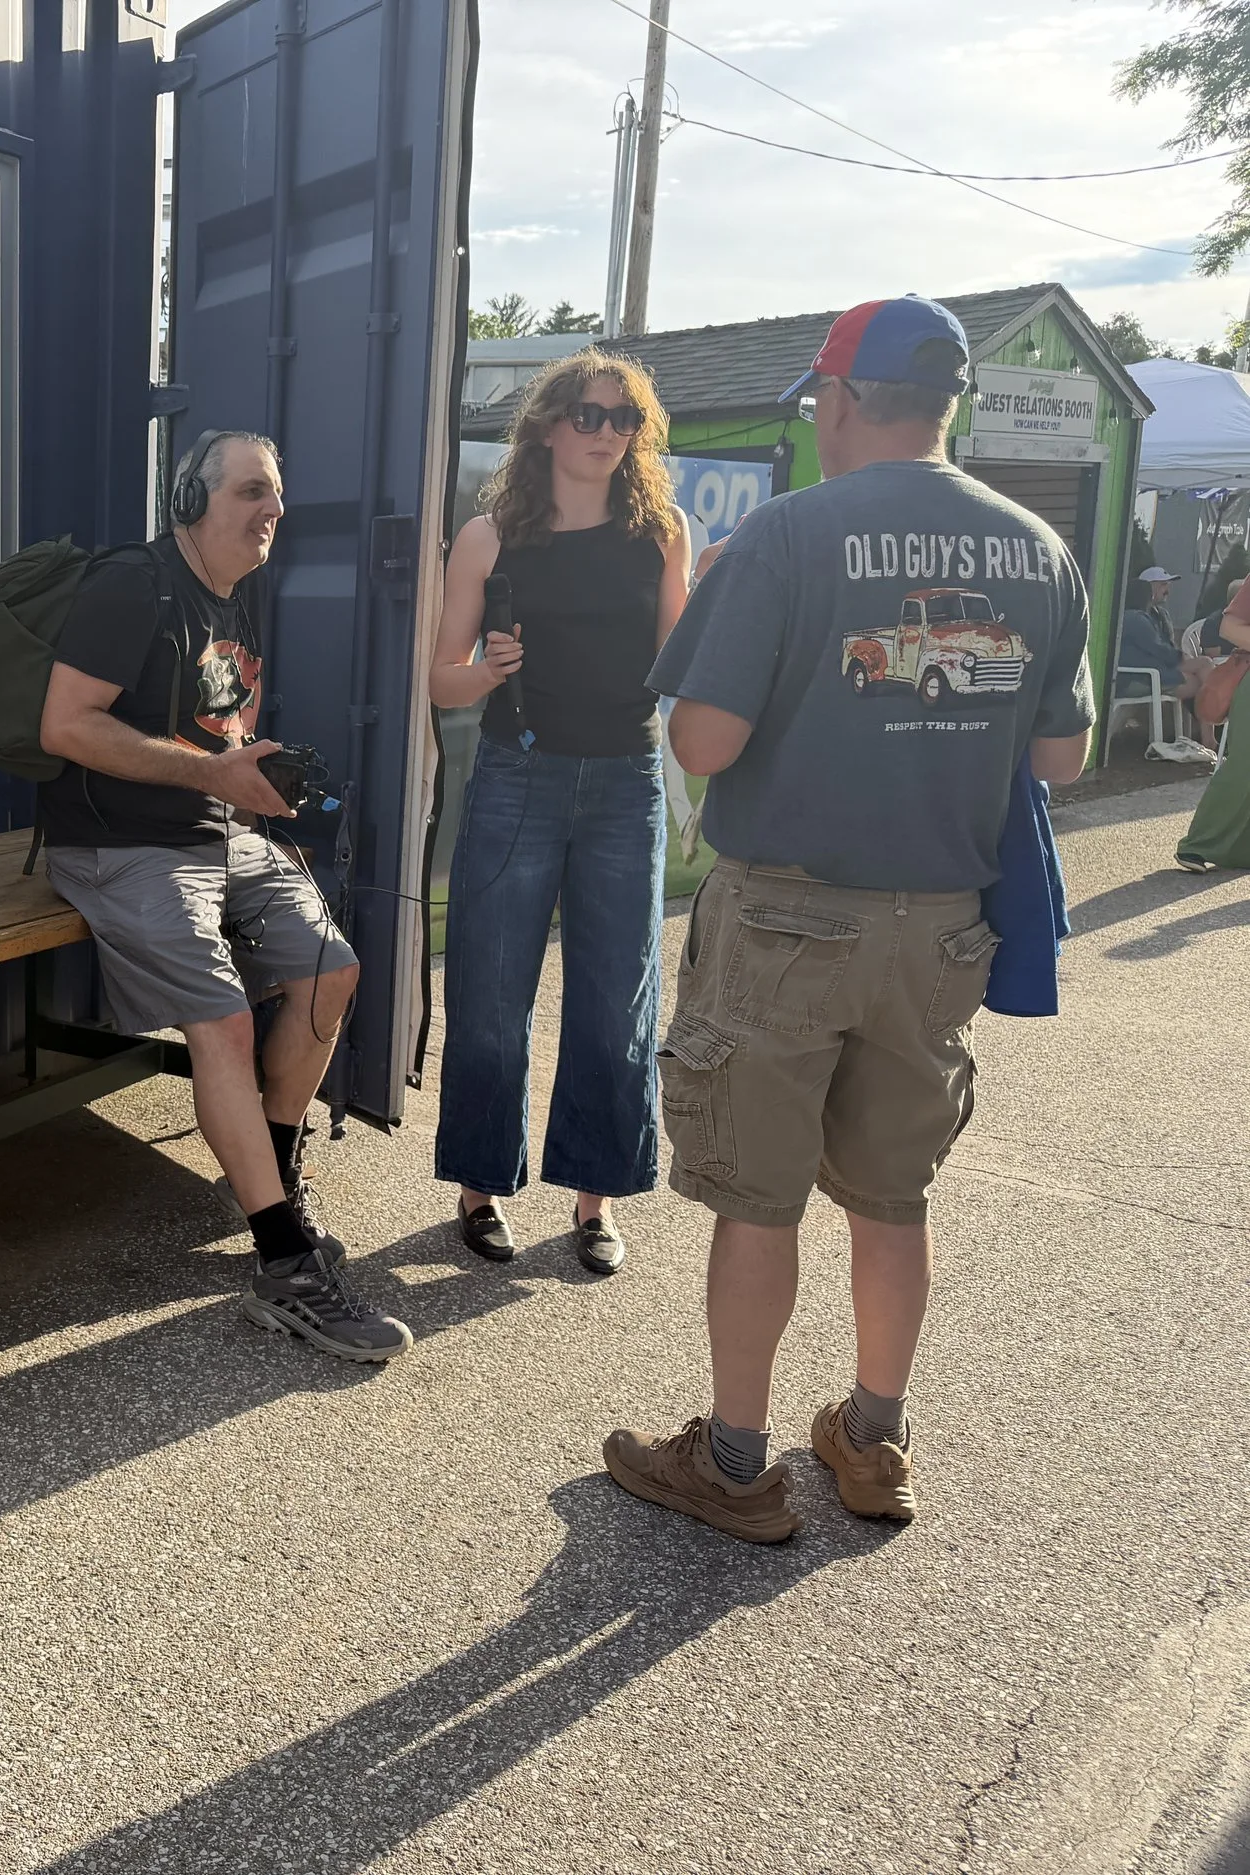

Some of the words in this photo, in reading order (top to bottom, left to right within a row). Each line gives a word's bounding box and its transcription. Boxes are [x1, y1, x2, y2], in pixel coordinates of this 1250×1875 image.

[978, 392, 1012, 414] GUEST
[1013, 394, 1063, 418] RELATIONS
[1064, 399, 1093, 420] BOOTH
[1024, 420, 1033, 429] CAN
[844, 533, 899, 580] OLD
[904, 532, 976, 579] GUYS
[984, 535, 1050, 583] RULE
[926, 721, 957, 731] THE
[960, 721, 990, 731] RUST
